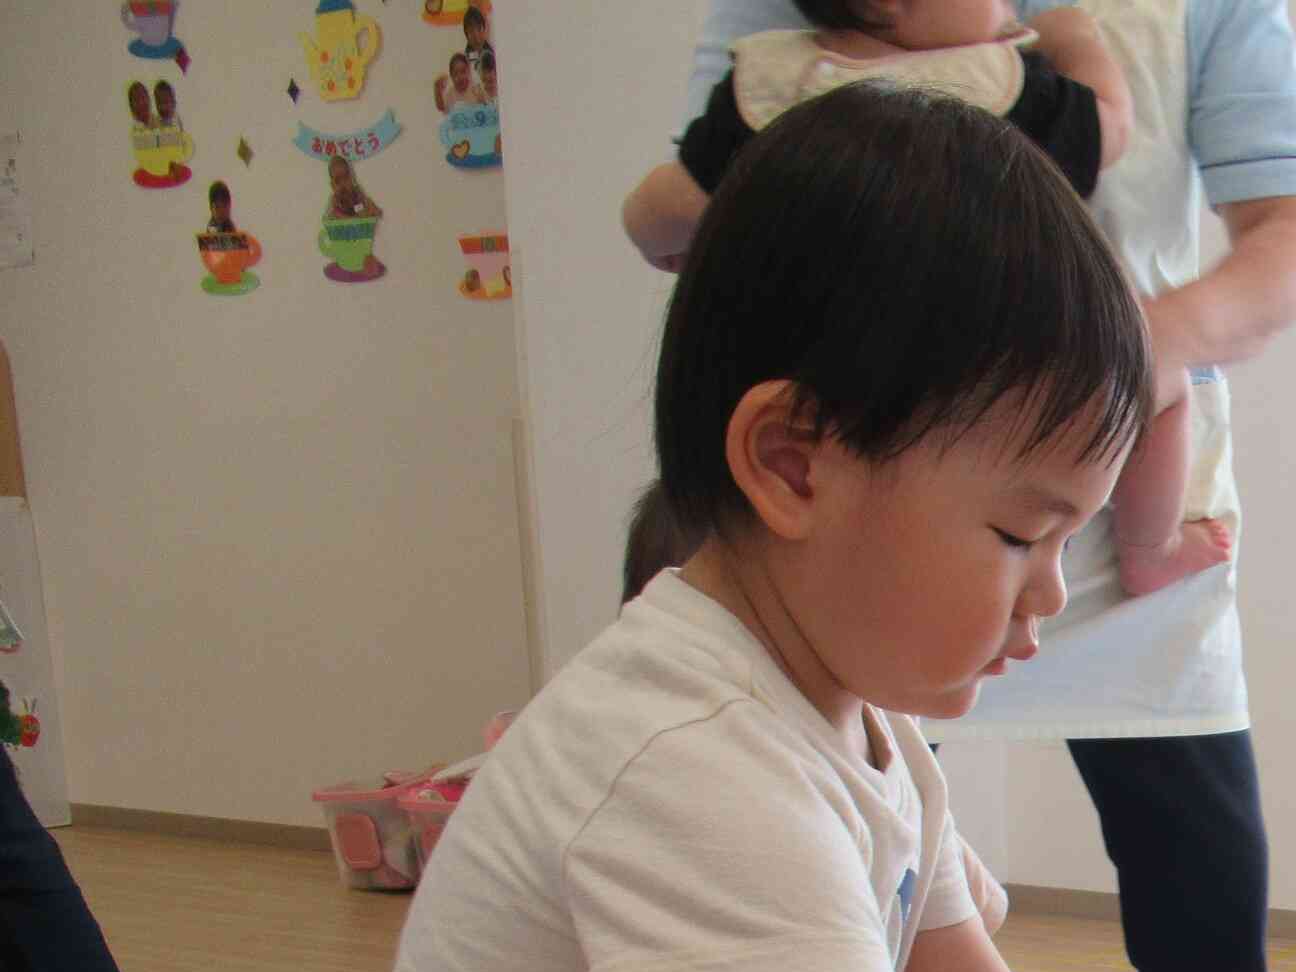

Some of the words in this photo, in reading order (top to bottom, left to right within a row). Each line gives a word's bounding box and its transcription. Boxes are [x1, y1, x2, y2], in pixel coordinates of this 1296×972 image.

[311, 132, 381, 157] おめでとう
